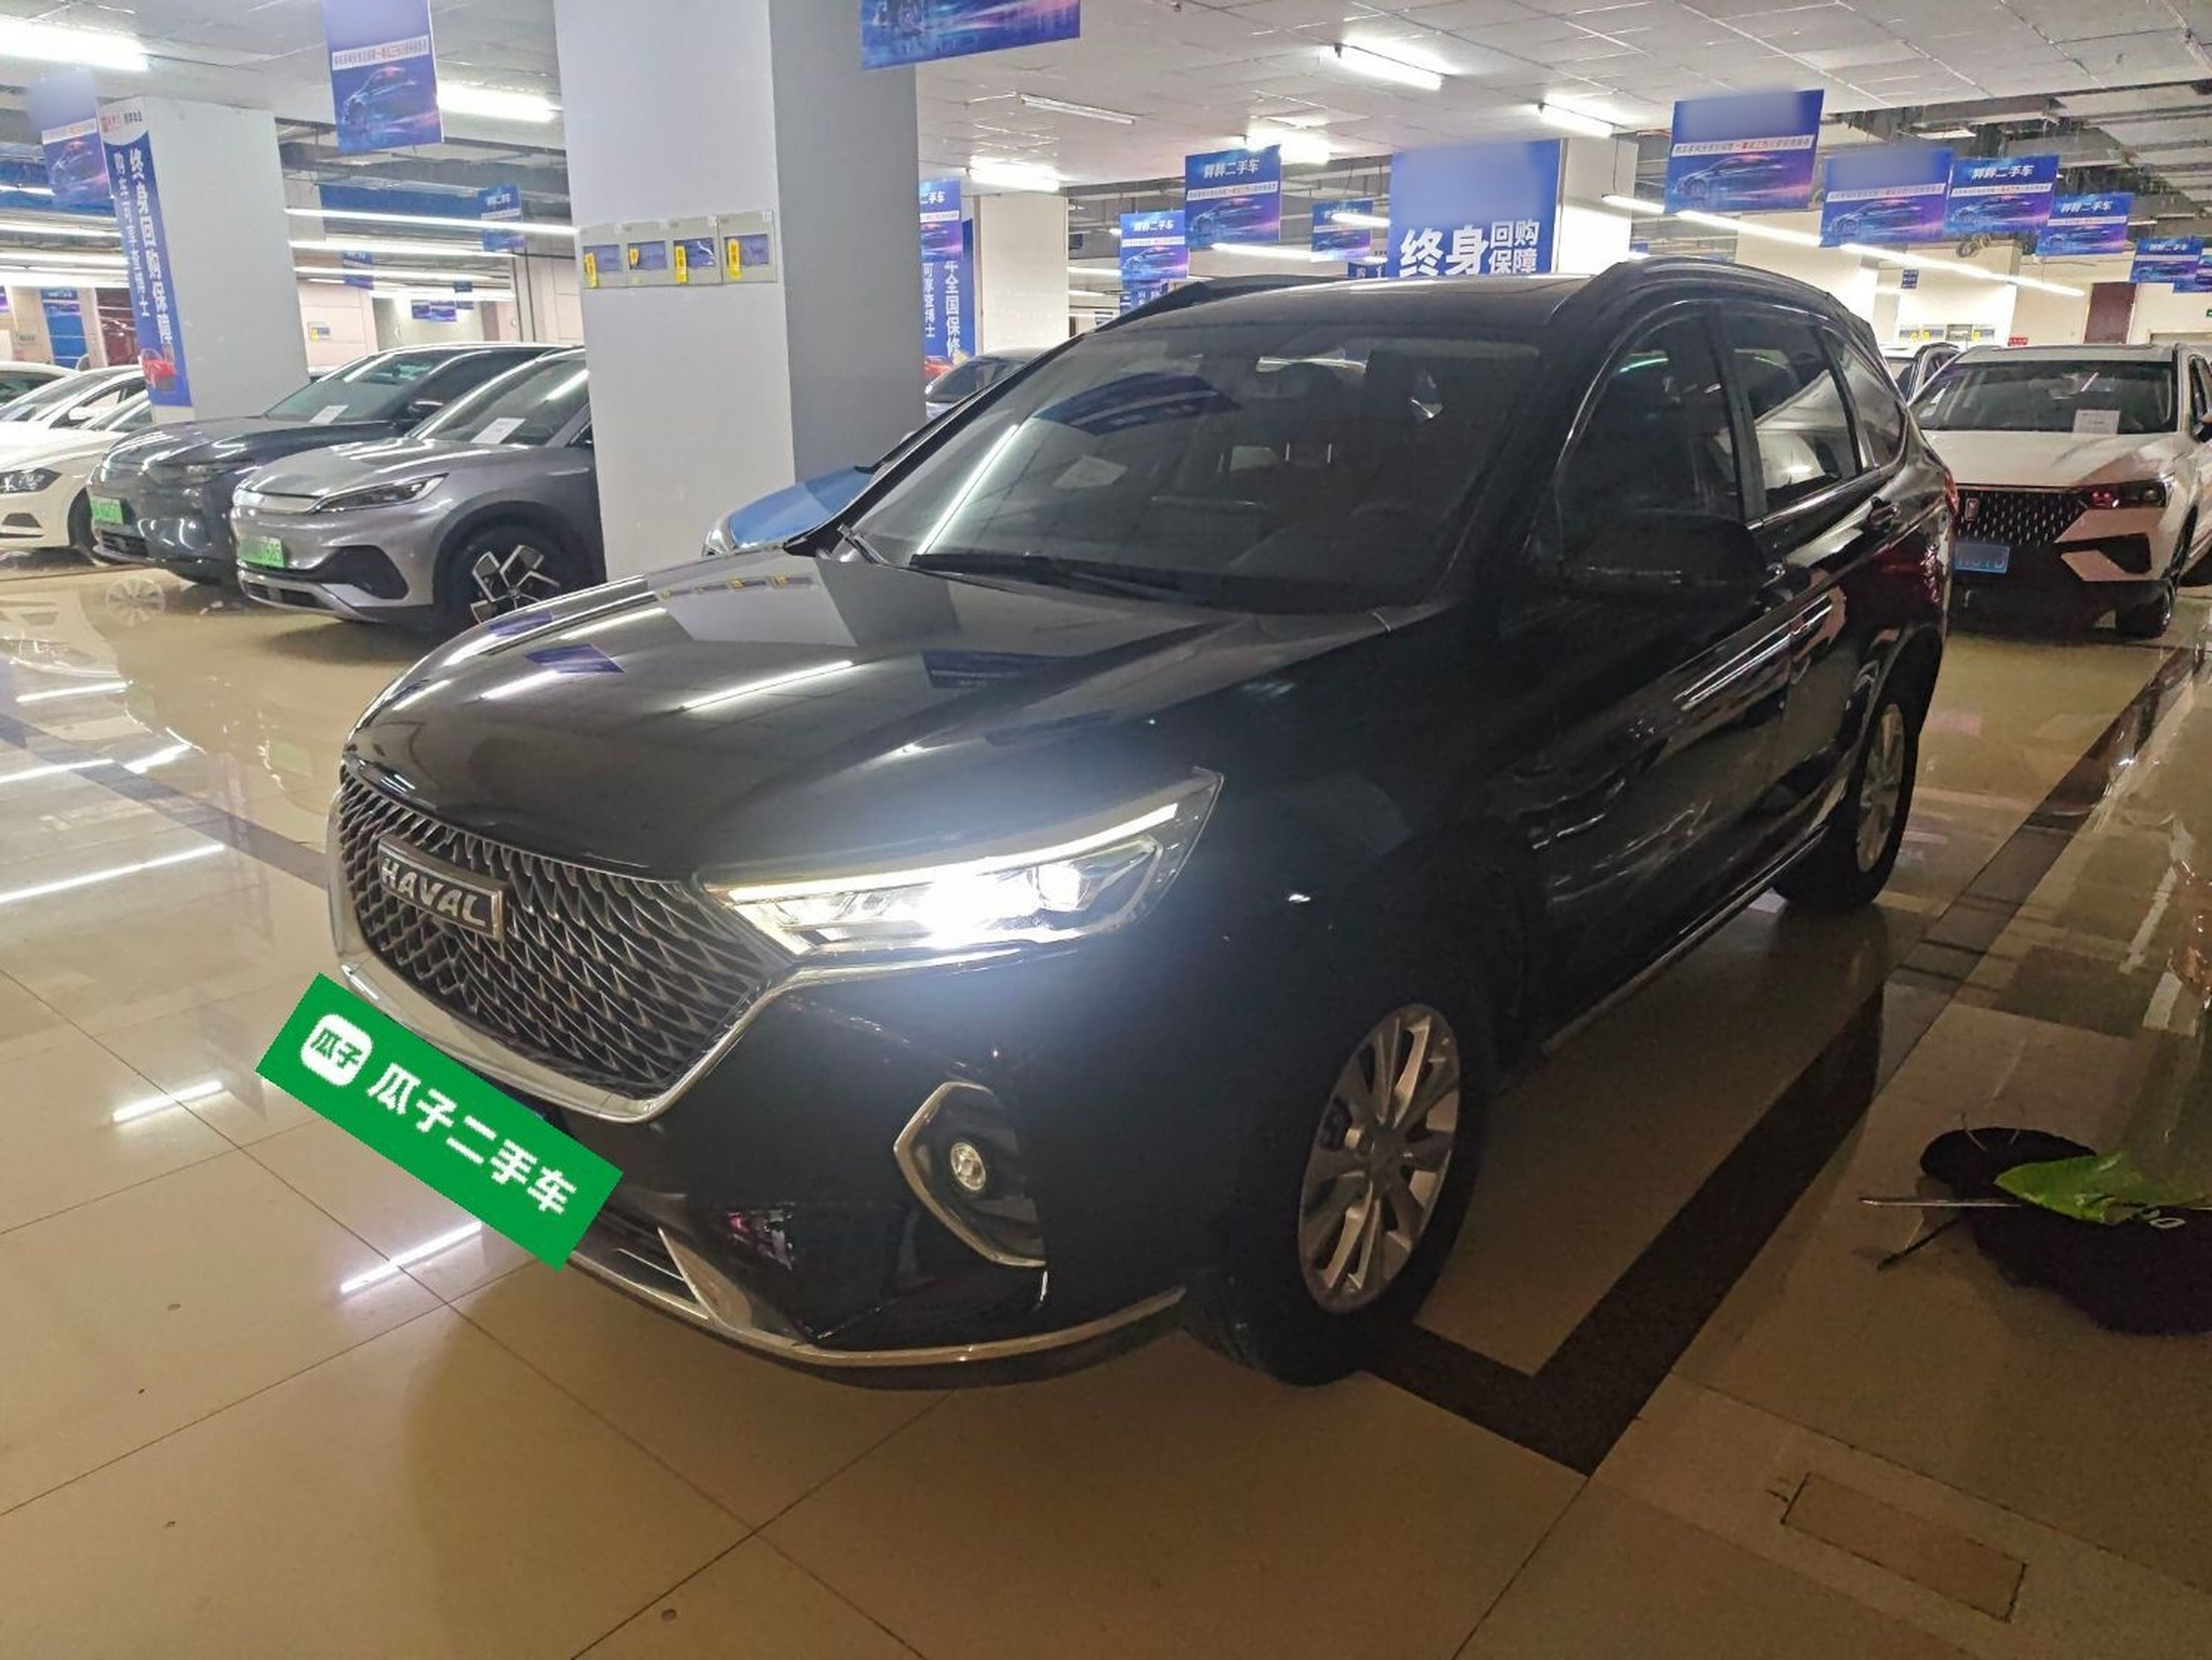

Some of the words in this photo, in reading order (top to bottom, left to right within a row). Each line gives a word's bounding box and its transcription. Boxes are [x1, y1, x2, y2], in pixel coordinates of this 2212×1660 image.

[129, 148, 172, 344] 终身回购保障
[1399, 225, 1489, 277] 终身
[1490, 220, 1540, 248] 回购
[1488, 248, 1537, 274] 保障
[380, 858, 486, 926] HAVAL
